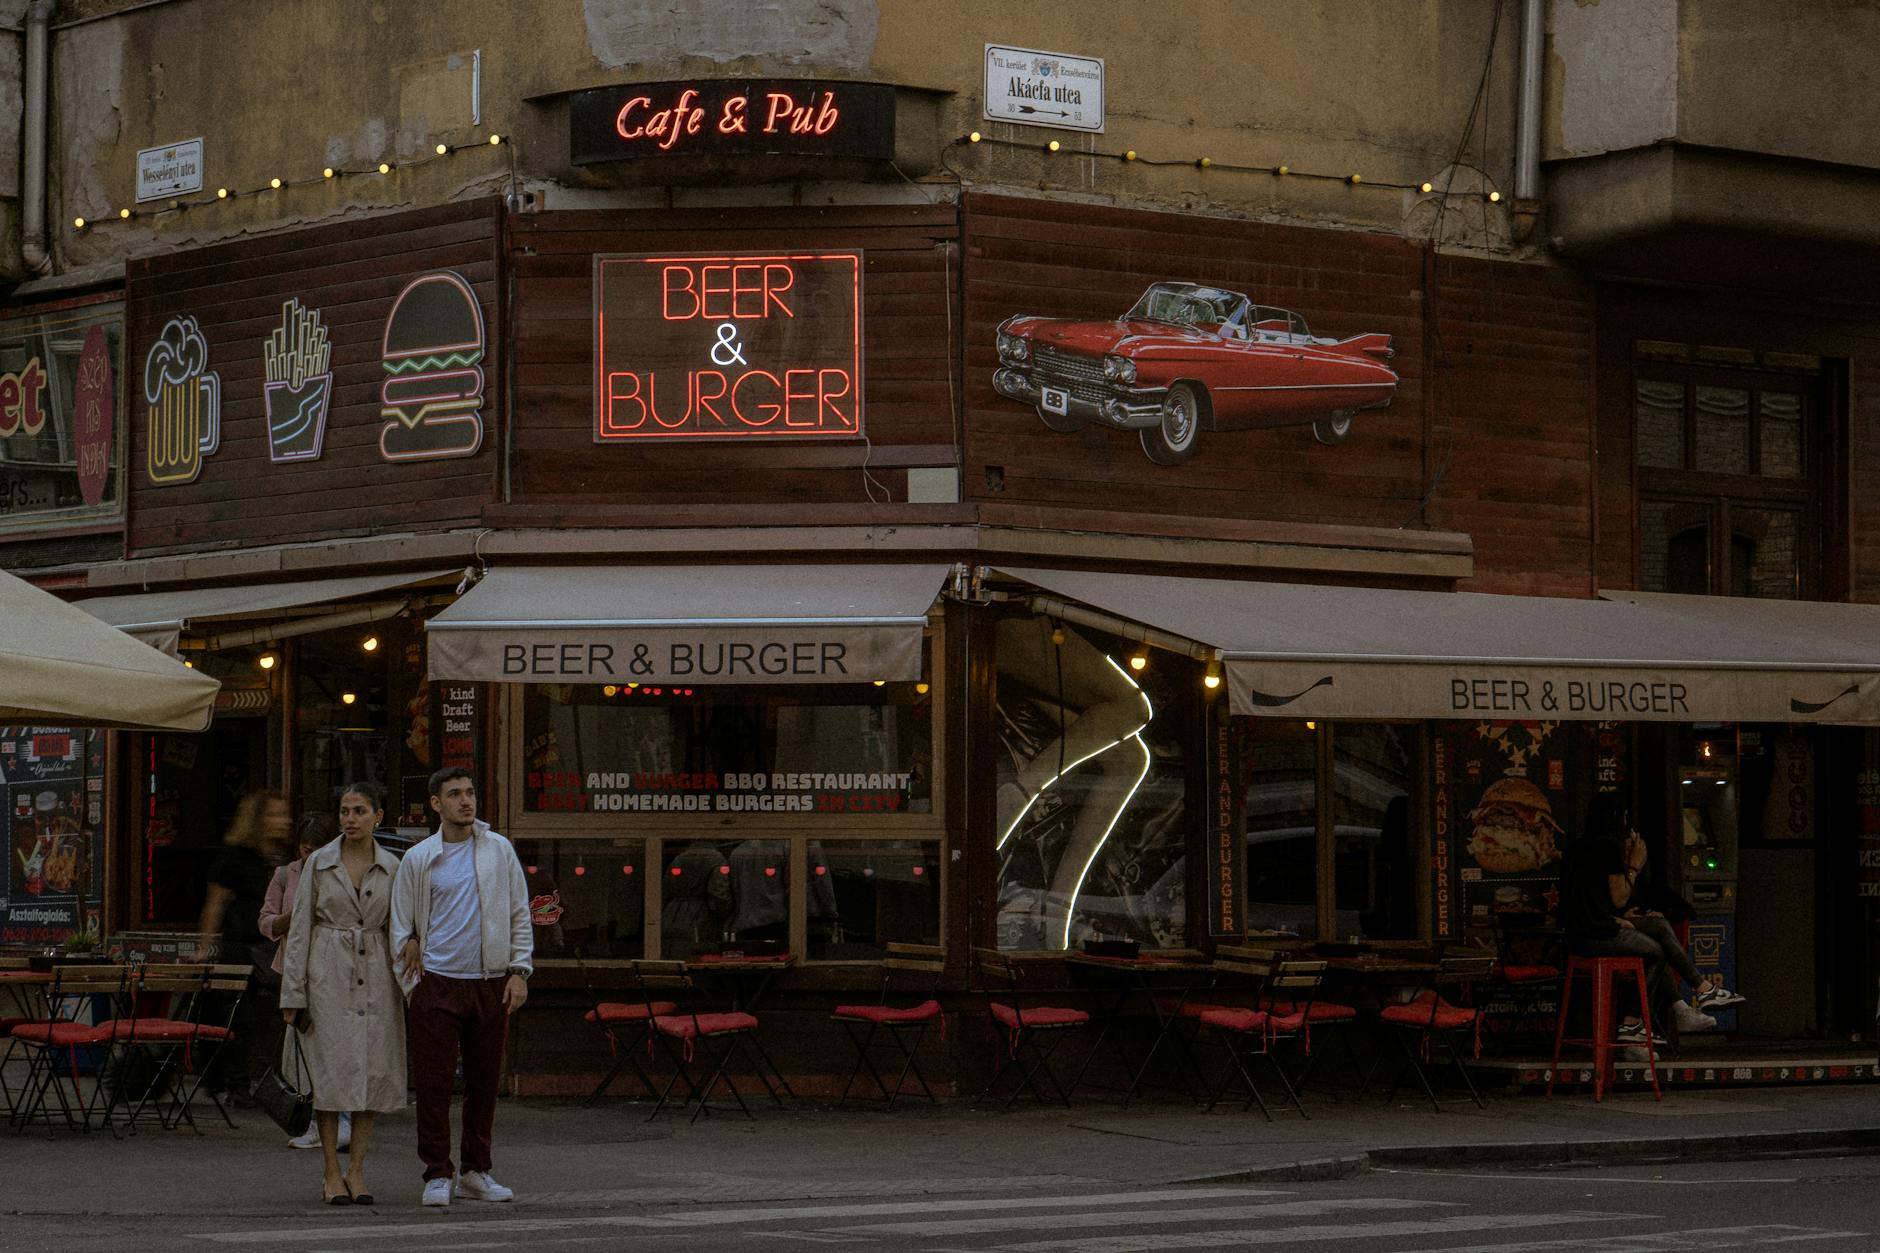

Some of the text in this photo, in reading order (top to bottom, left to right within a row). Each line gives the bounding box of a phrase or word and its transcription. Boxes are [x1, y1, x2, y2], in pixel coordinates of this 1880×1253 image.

[1007, 76, 1082, 105] Akácfa utca
[616, 89, 840, 149] Cafe & Pub
[663, 264, 794, 320] BEER
[710, 323, 747, 366] &
[607, 368, 850, 429] BURGER
[503, 642, 848, 675] BEER & BURGER
[449, 687, 475, 700] kind
[1451, 679, 1689, 713] BEER & BURGER
[442, 704, 474, 716] Draft
[446, 720, 471, 732] Beer
[586, 773, 629, 789] AND
[724, 773, 767, 790] BBQ
[771, 773, 911, 790] RESTAURANT
[593, 794, 711, 811] HOMEMADE
[715, 794, 813, 811] BURGERS
[9, 908, 71, 923] Asztalfoglalás:
